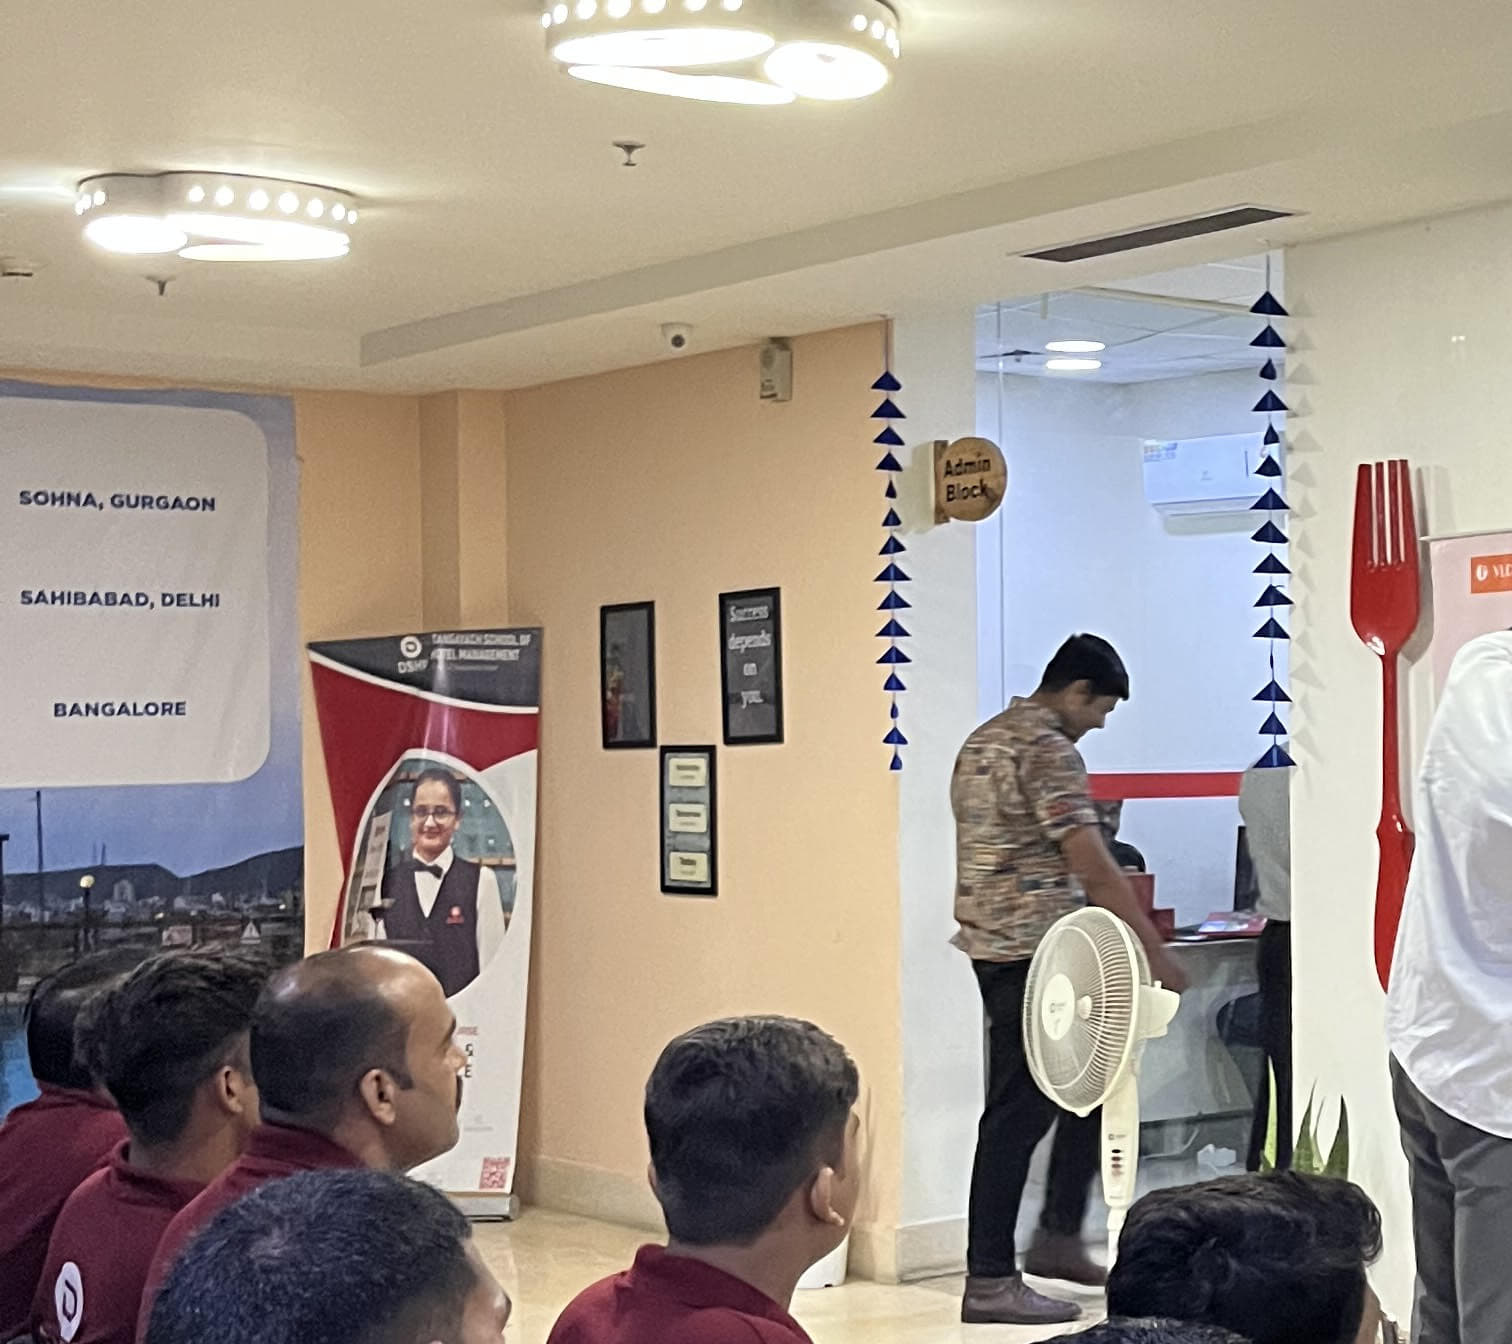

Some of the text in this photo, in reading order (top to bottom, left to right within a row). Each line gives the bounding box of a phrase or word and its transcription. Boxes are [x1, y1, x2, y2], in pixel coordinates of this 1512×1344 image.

[944, 452, 991, 478] Admin
[19, 490, 216, 511] SOHNA, GURGAON
[946, 478, 989, 502] Block
[20, 590, 220, 610] SAHIBABAD, DELHI
[54, 701, 187, 718] BANGALORE
